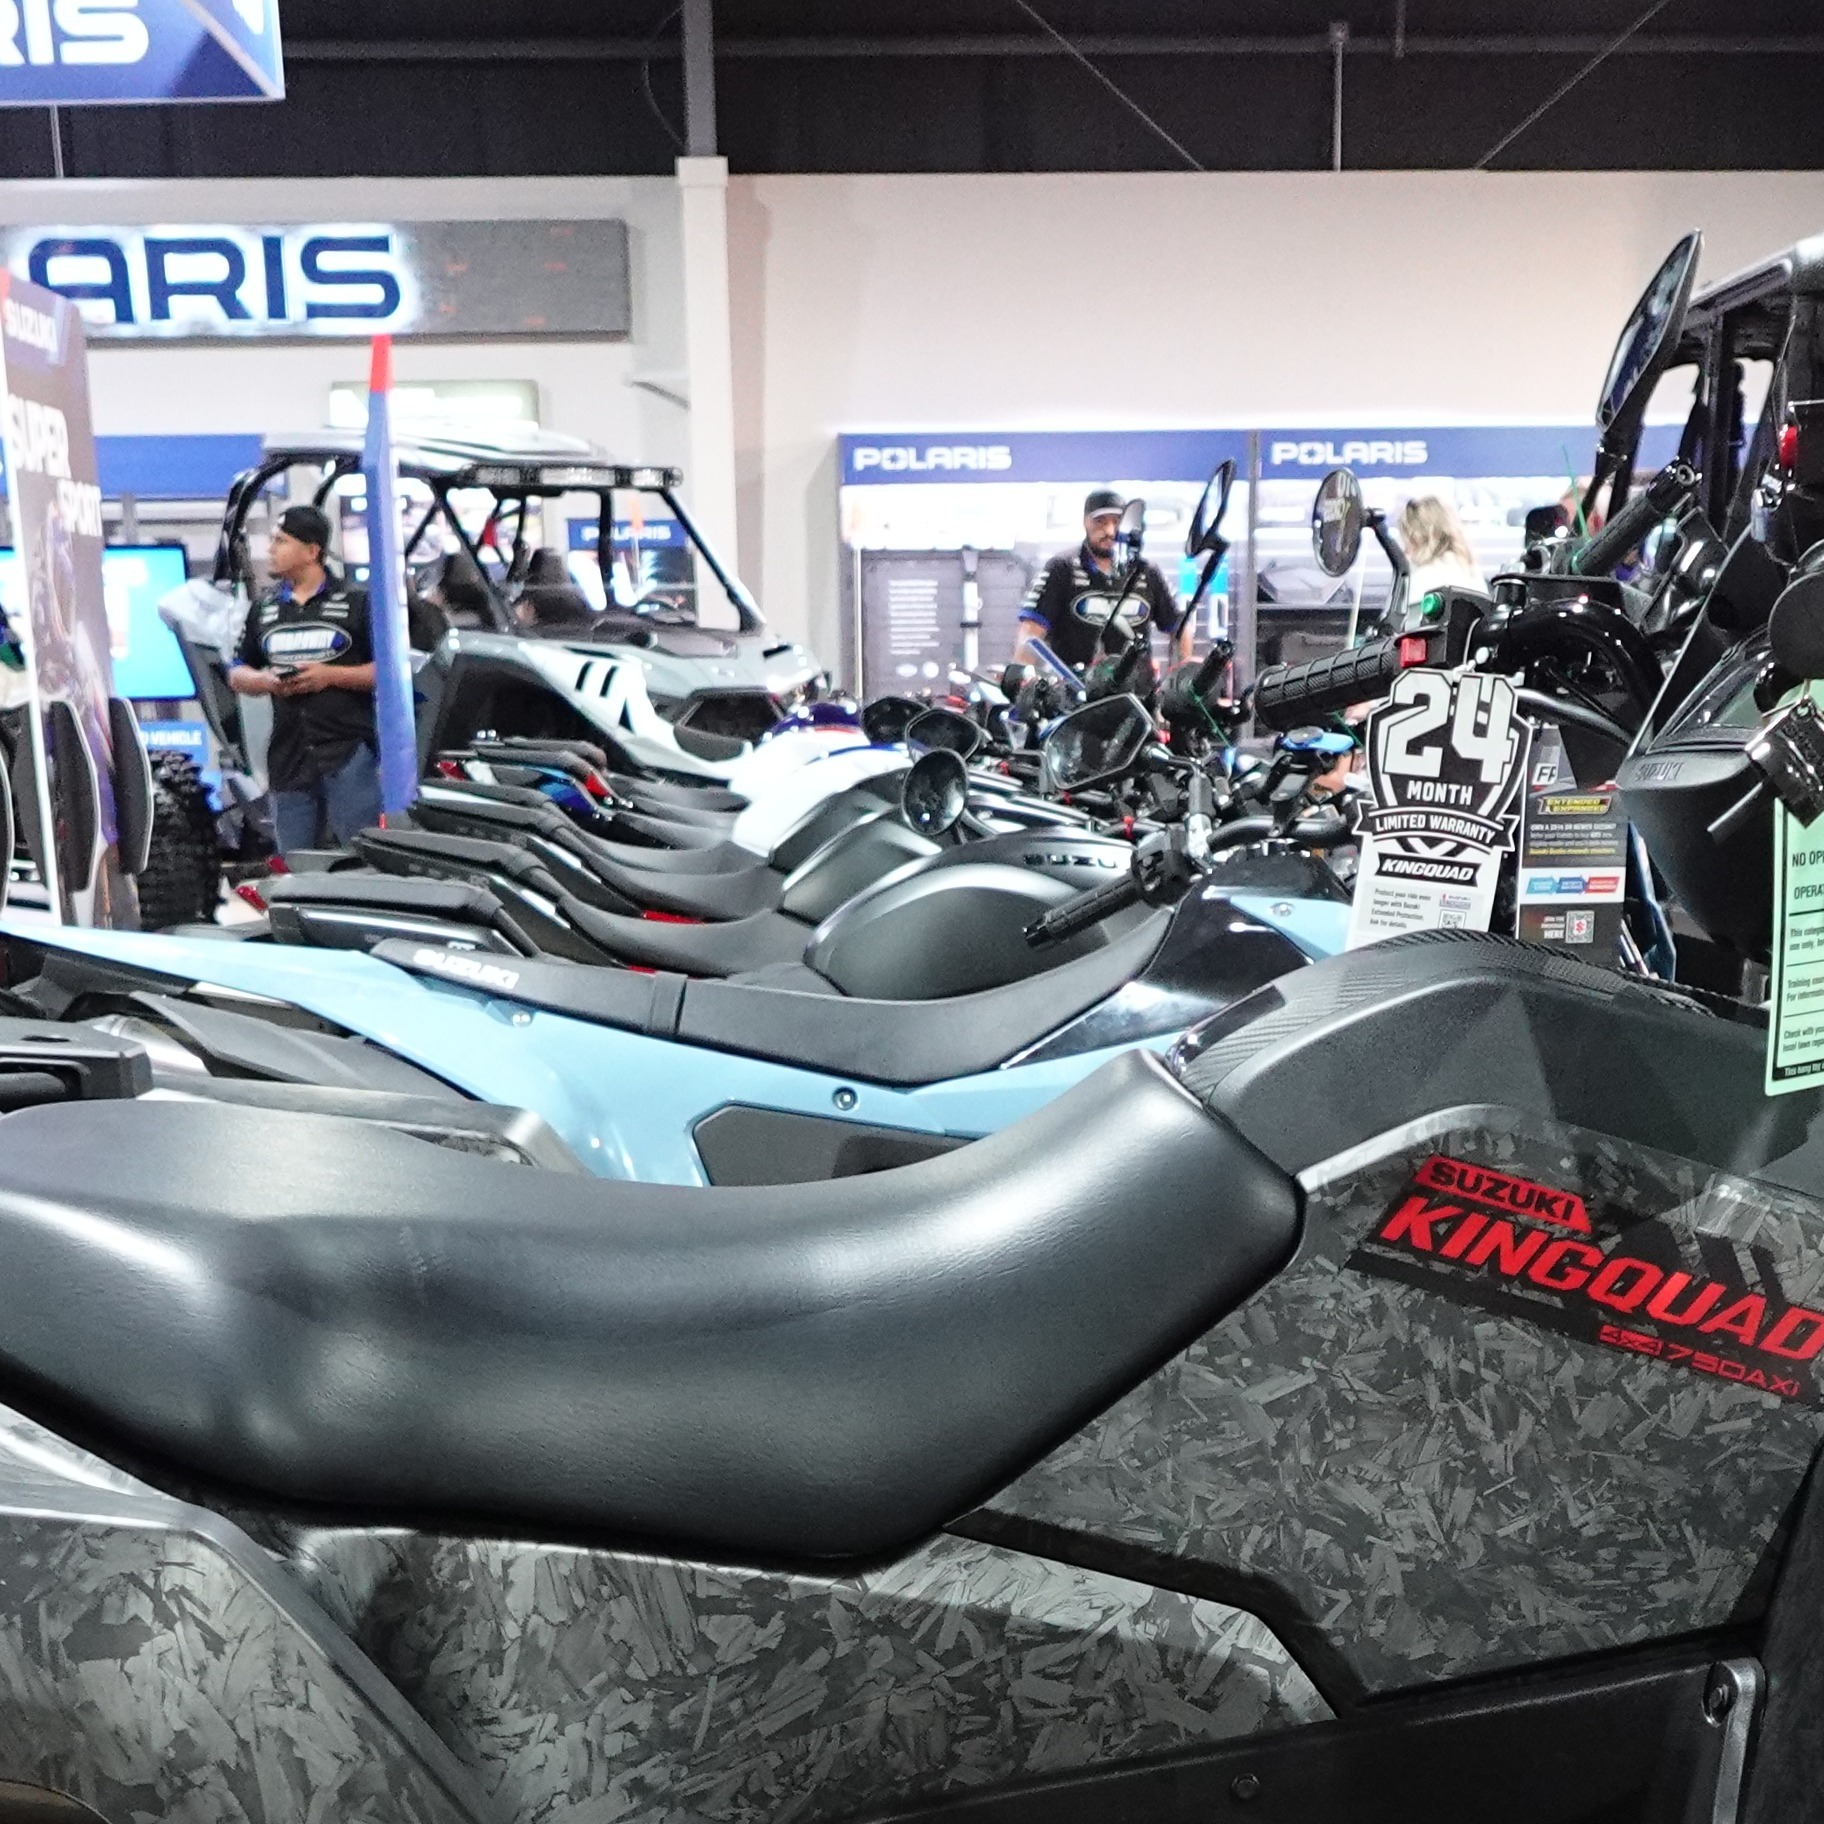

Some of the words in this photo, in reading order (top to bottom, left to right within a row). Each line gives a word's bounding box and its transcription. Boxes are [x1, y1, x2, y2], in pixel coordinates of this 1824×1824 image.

[4, 299, 58, 354] SUZUKI
[6, 394, 72, 479] SUPER
[853, 446, 1011, 471] POLARIS
[1271, 440, 1428, 465] POLARIS
[57, 478, 103, 538] SPORT
[581, 524, 671, 541] PLARIS
[1383, 670, 1515, 784] 24
[1407, 780, 1473, 806] MONTH
[1376, 814, 1426, 832] LIMITED
[1429, 814, 1496, 844] WARRANTY
[1023, 853, 1119, 869] SUZU
[1381, 858, 1475, 881] KINGQUAD
[1792, 851, 1807, 868] NO
[413, 948, 520, 990] SUZUKI
[1428, 1160, 1579, 1223] SUZUKI
